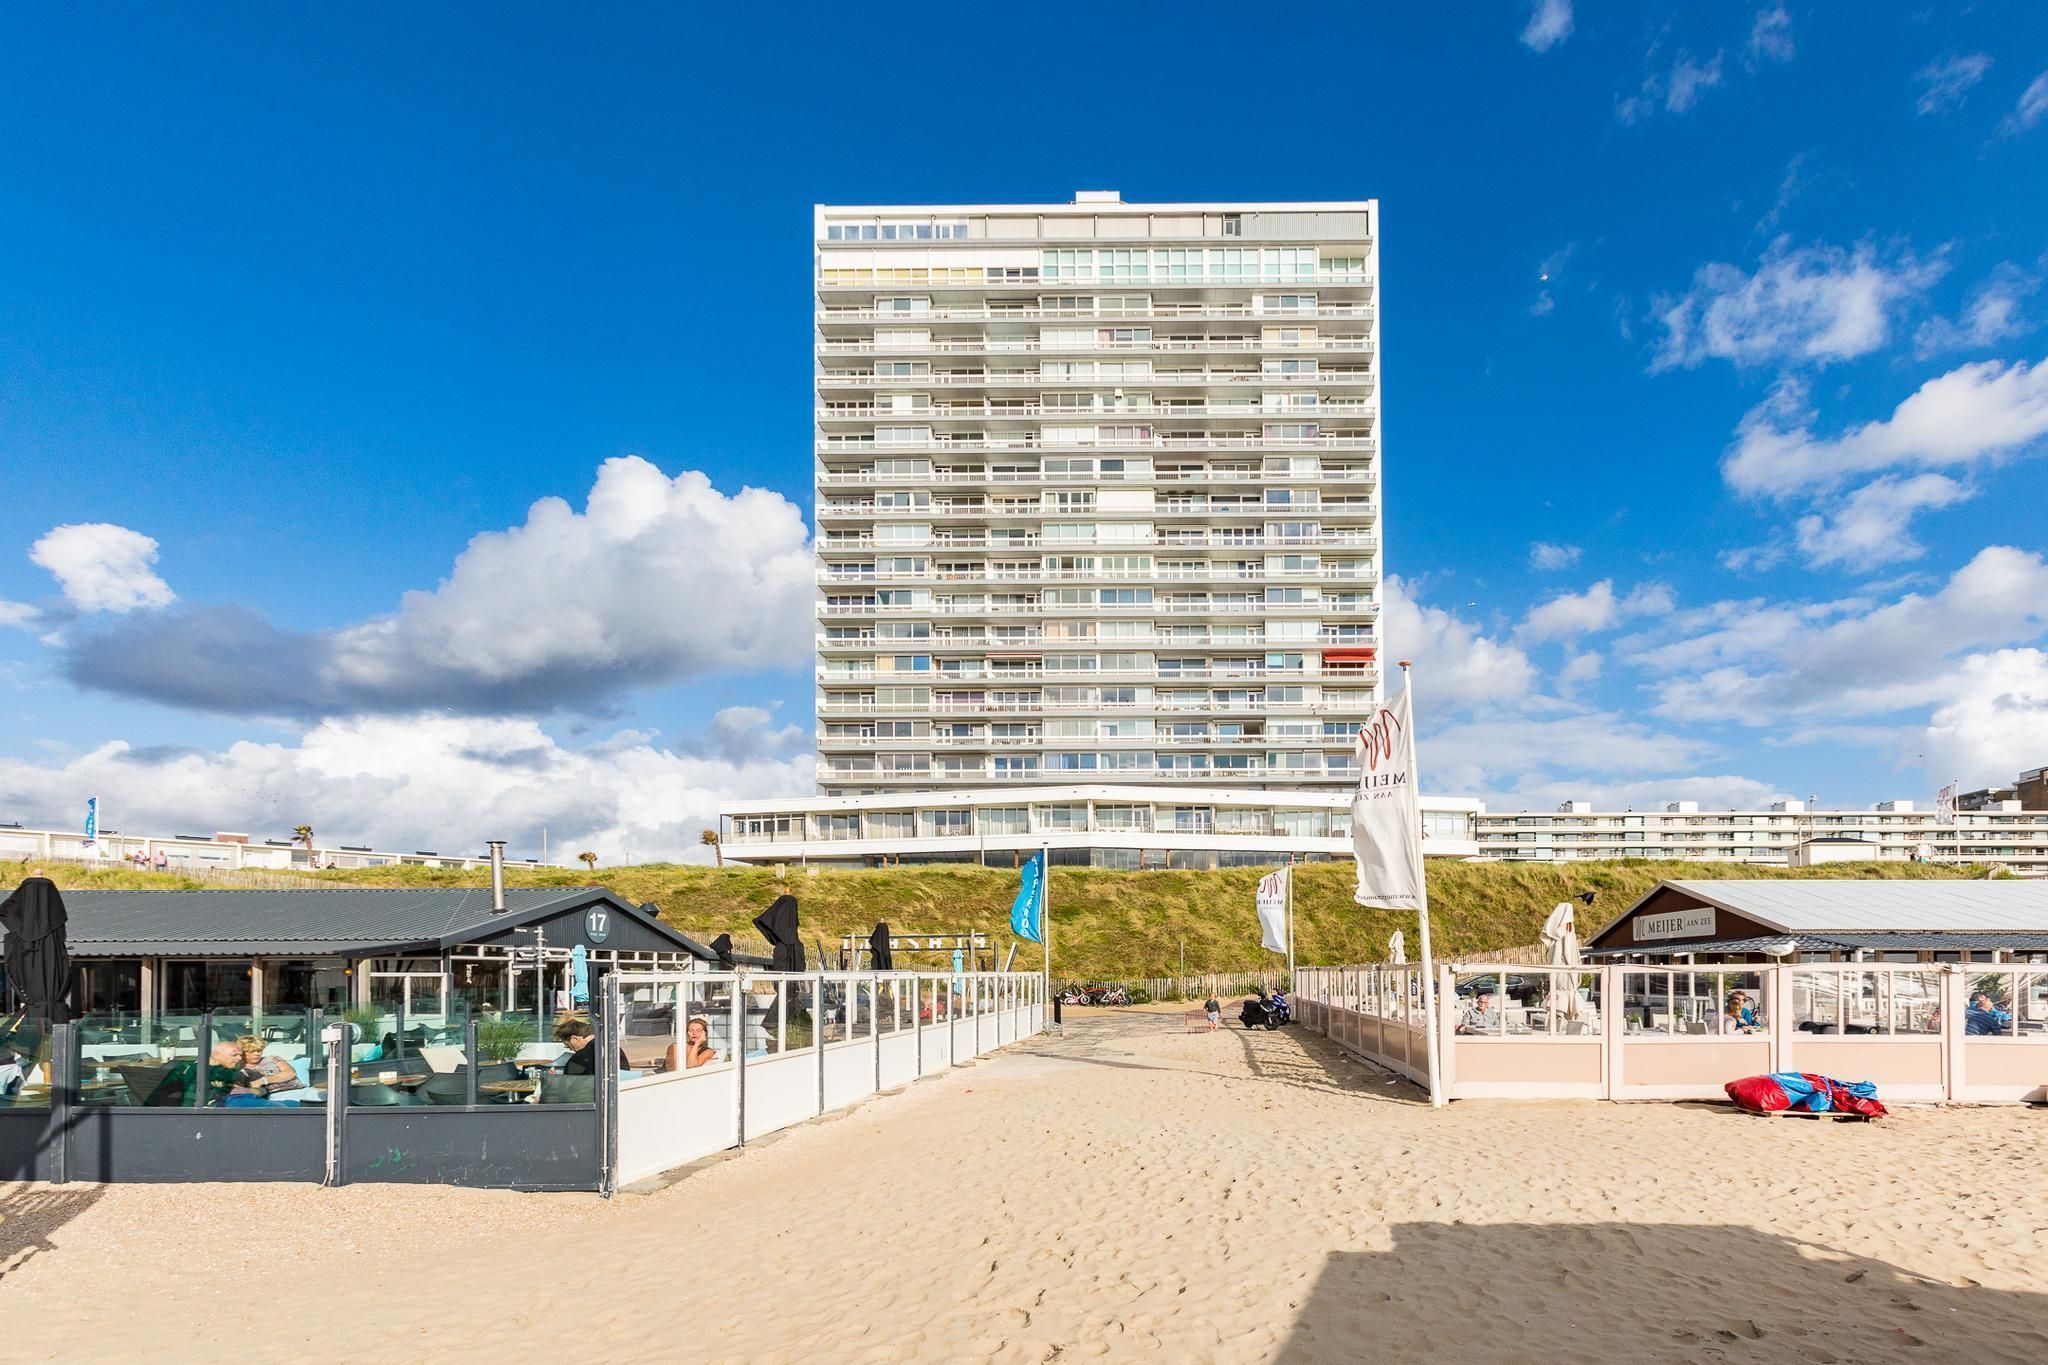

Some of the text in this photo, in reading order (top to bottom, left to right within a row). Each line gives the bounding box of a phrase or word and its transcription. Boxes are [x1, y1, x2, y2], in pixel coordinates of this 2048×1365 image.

[589, 912, 607, 931] 17
[1648, 917, 1712, 934] MEIJER AAN ZEE
